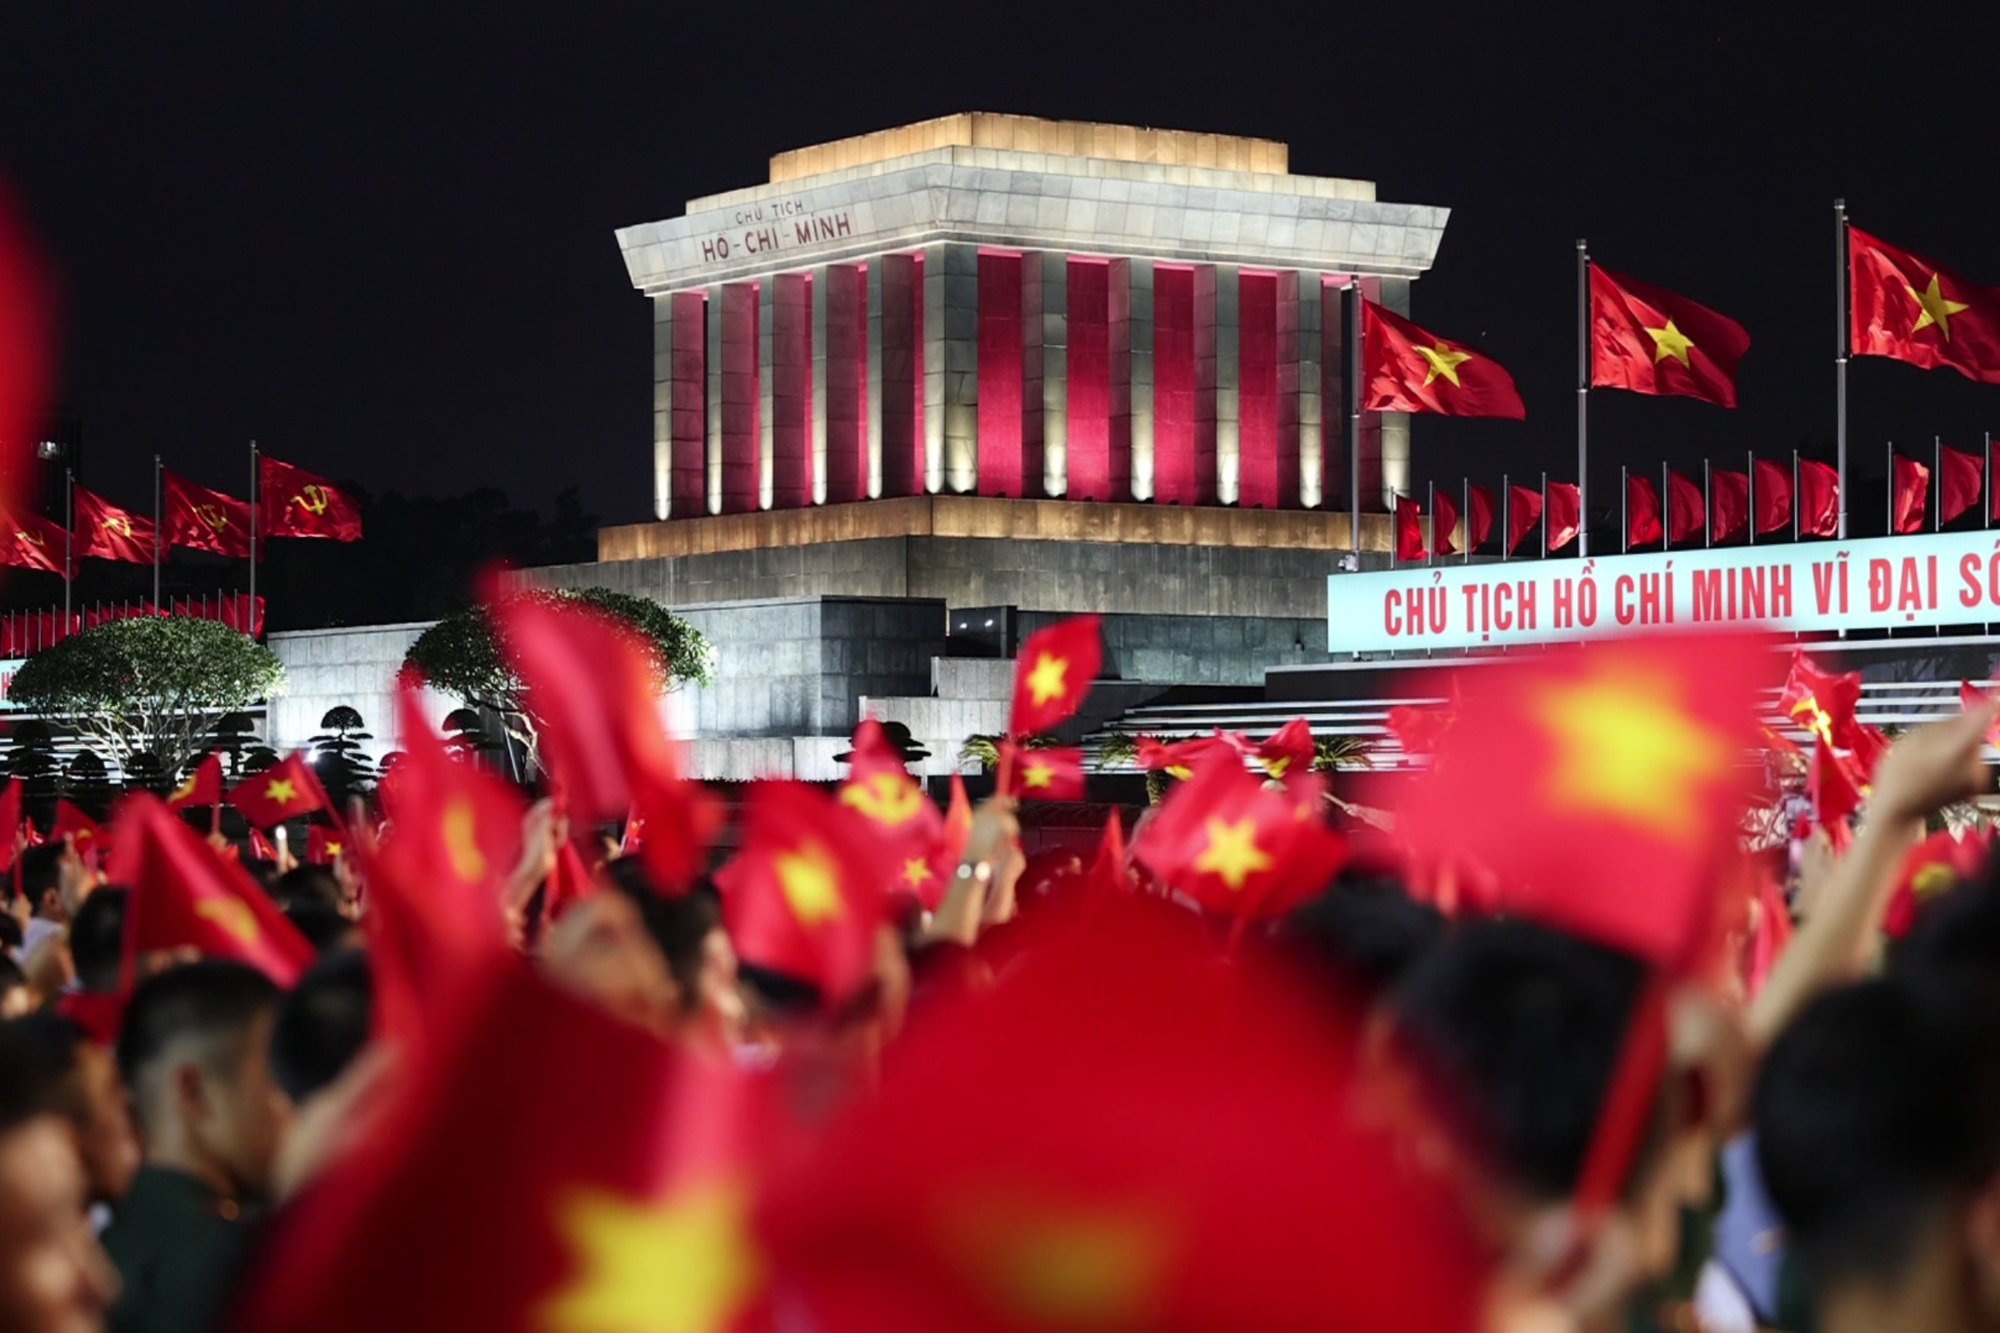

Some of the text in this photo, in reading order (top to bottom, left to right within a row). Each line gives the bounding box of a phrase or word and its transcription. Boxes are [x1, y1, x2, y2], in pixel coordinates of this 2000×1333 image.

[1384, 571, 1447, 636] CHỦ
[1462, 581, 1536, 642] TỊCH
[1553, 559, 1597, 628] HỒ
[1615, 560, 1673, 626] CHÍ
[1692, 564, 1792, 622] MINH
[1812, 550, 1850, 615] VĨ
[1868, 555, 1938, 622] ĐẠI
